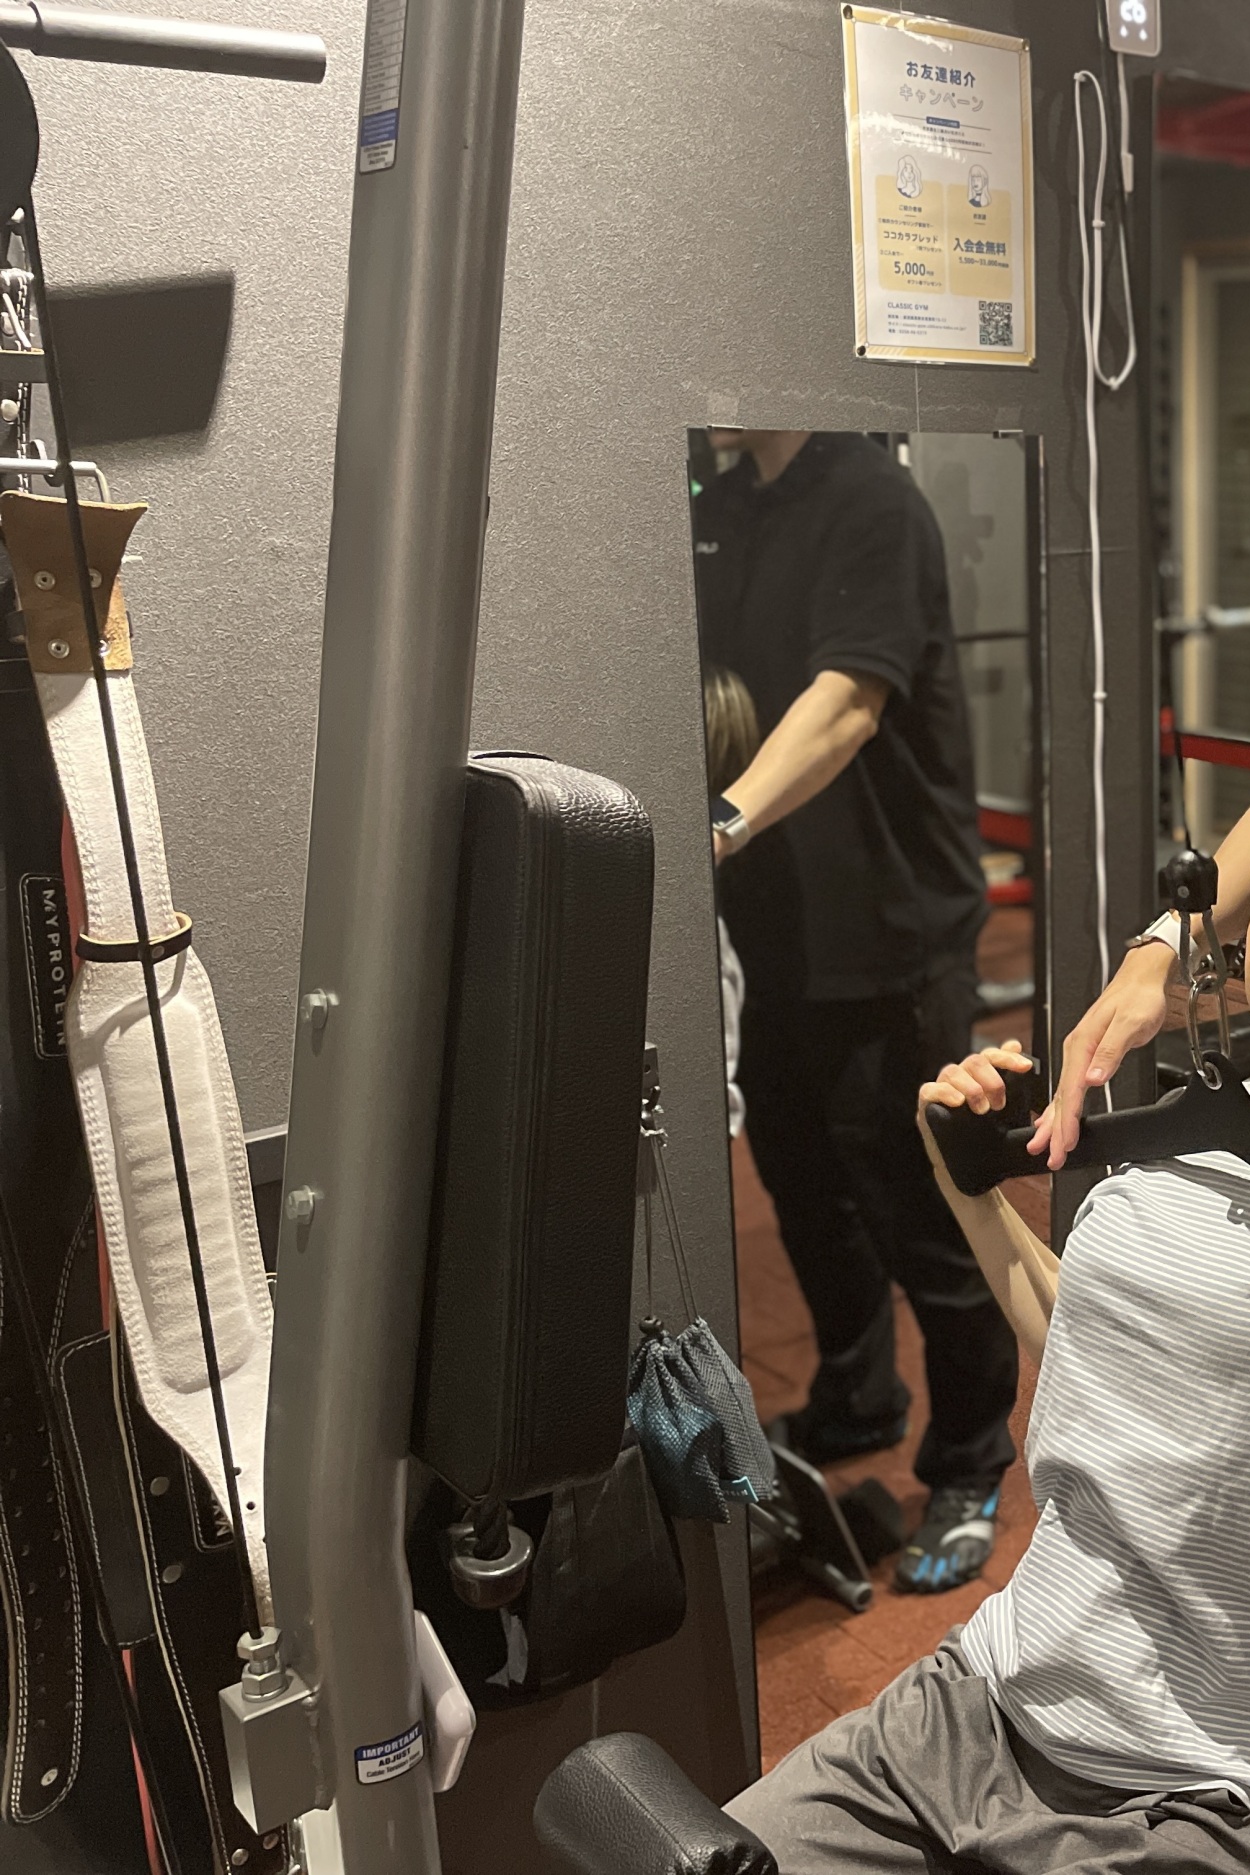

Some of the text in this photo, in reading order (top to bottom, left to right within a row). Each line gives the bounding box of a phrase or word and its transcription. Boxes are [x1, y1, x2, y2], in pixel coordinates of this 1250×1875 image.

[906, 61, 976, 88] お友達紹介
[900, 83, 984, 112] キャンペーン
[953, 237, 1006, 256] 入会金無料
[887, 301, 929, 311] CLASSIC GYM
[362, 1726, 420, 1759] IMPORTANT
[378, 1748, 411, 1767] ADJUST
